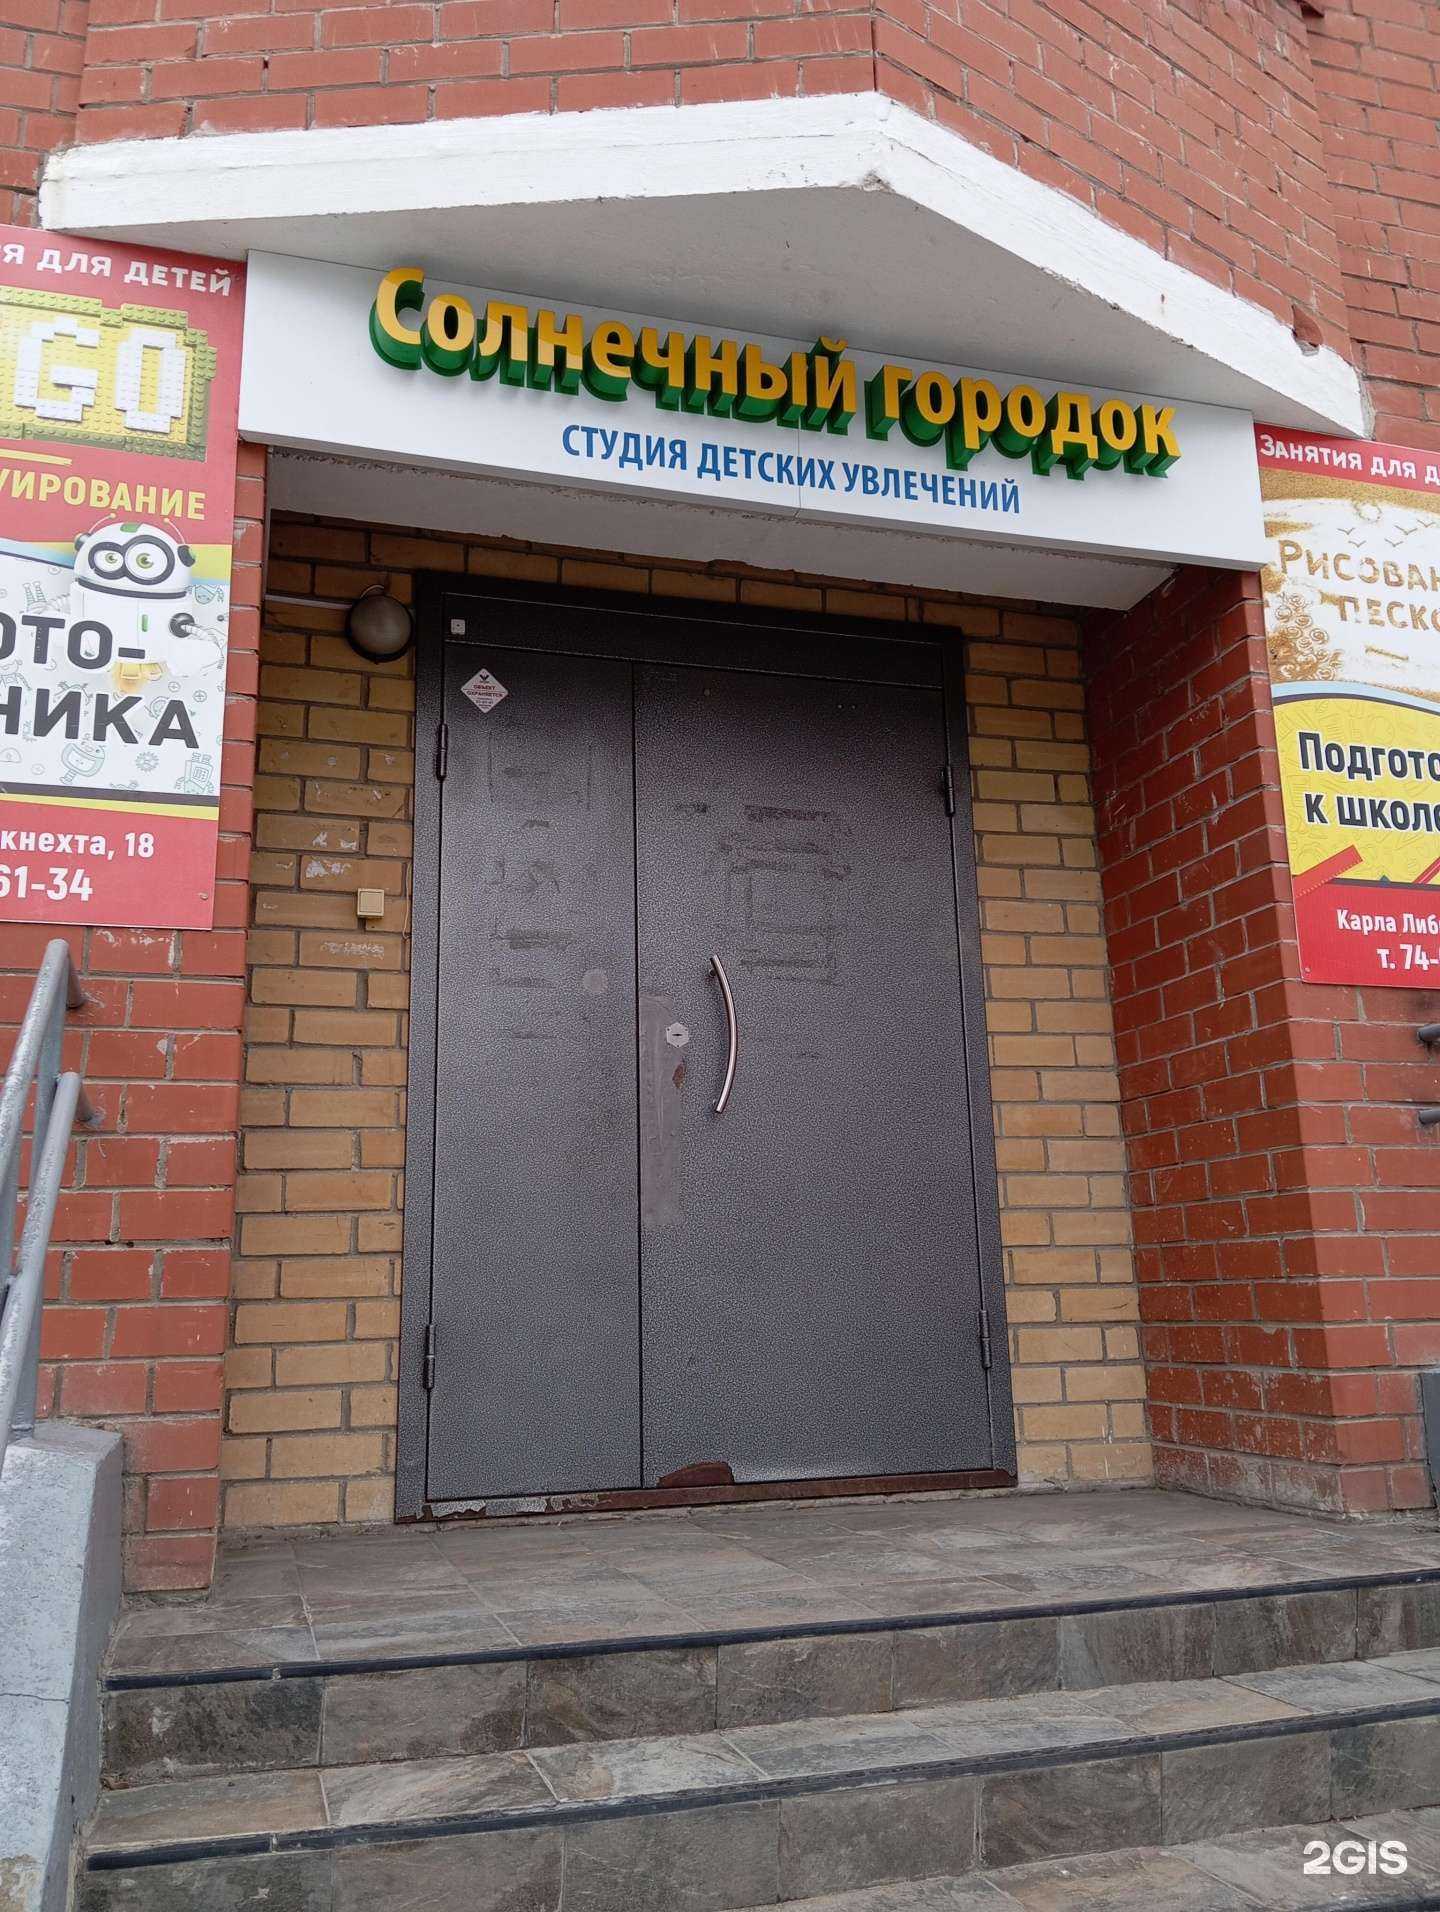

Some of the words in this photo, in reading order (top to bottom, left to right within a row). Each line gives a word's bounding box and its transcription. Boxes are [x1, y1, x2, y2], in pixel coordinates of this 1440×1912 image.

[0, 243, 25, 265] Я
[36, 249, 112, 277] ДЛЯ
[124, 261, 232, 297] ДЕТЕЙ
[371, 266, 857, 434] Солнечный
[865, 363, 1181, 480] городок
[561, 424, 687, 471] СТУДИЯ
[696, 443, 836, 491] ДЕТСКИХ
[841, 462, 1020, 514] УВЛЕЧЕНИЙ
[1, 829, 115, 861] кнехта,
[125, 832, 155, 859] 18
[0, 863, 94, 902] 61-34
[1336, 909, 1397, 937] Карла
[1402, 913, 1440, 936] Либ
[1376, 948, 1396, 970] т.
[1400, 943, 1440, 972] 74-
